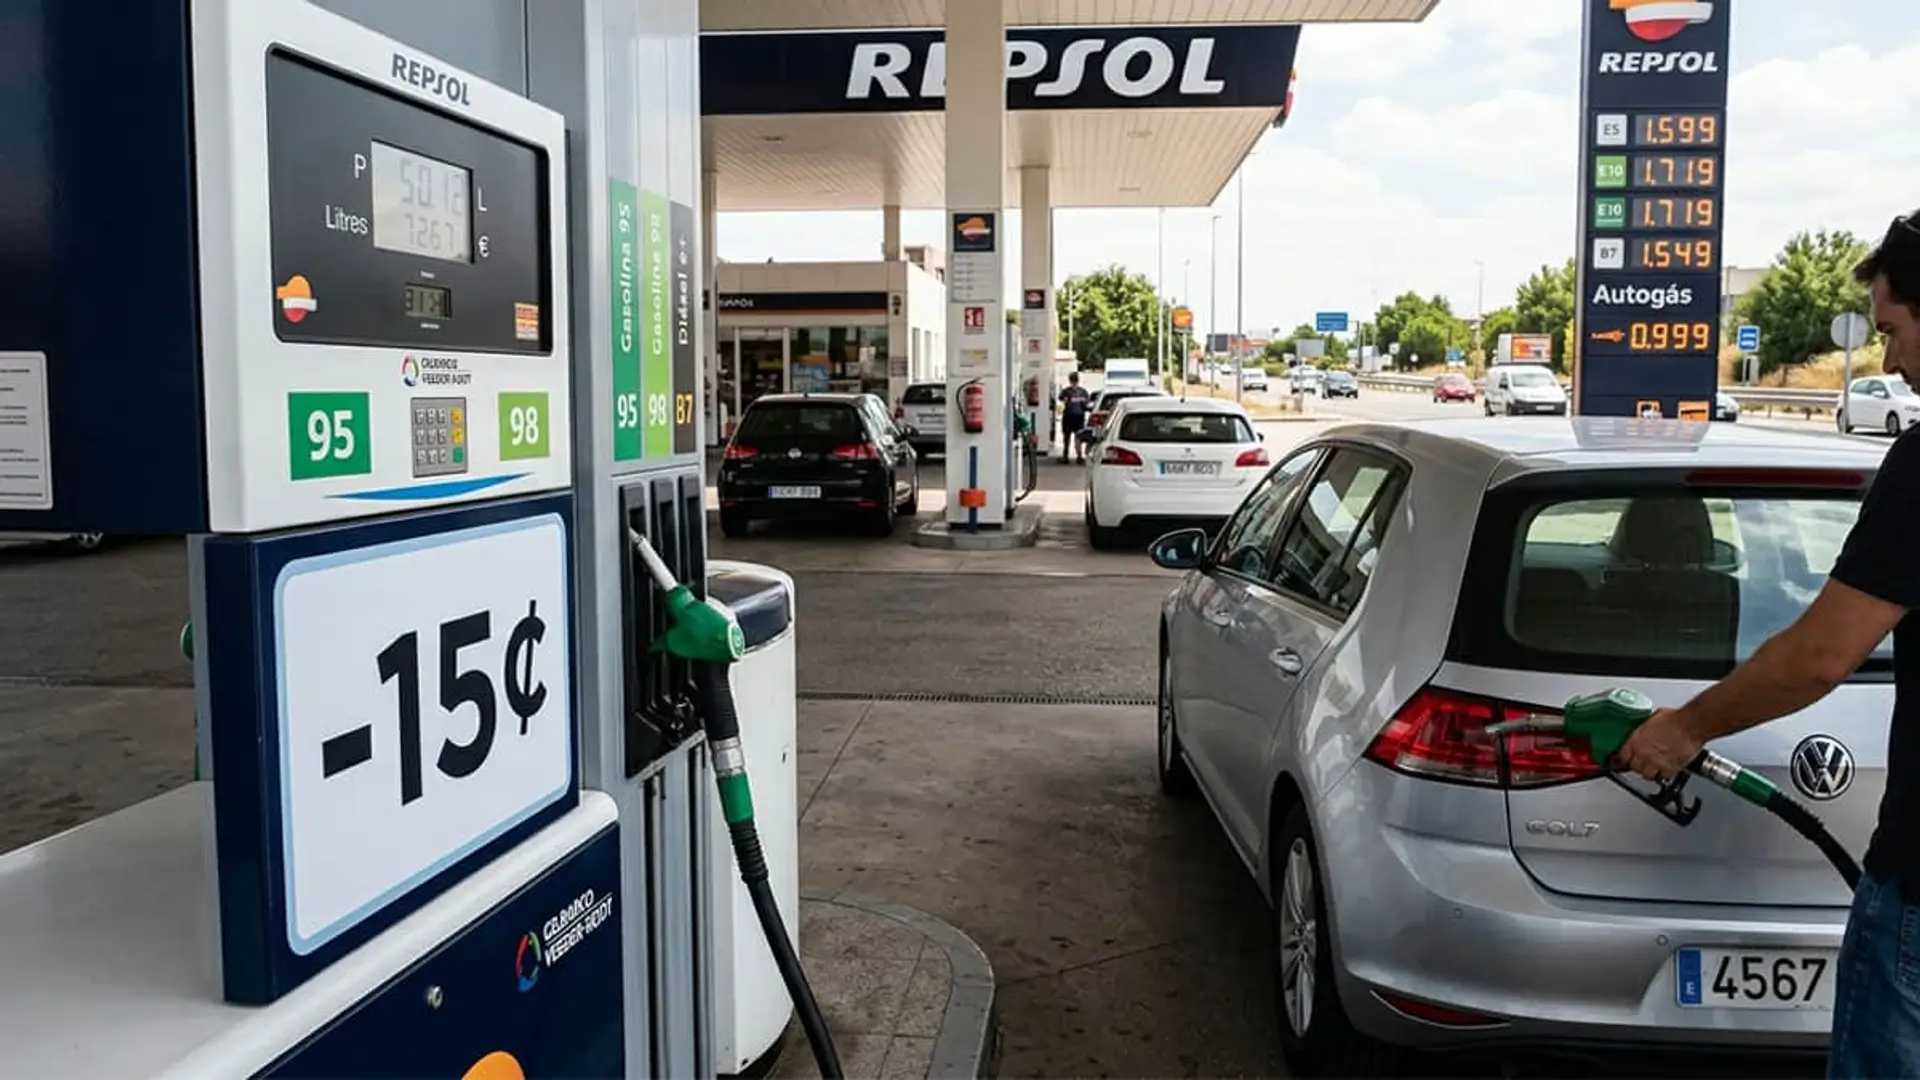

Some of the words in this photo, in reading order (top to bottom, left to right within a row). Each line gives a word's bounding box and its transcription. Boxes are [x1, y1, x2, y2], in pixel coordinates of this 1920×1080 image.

[1598, 51, 1718, 73] REPSOL
[391, 53, 471, 106] REPSOL
[1646, 116, 1716, 144] 1.599
[1599, 164, 1624, 178] E10
[1645, 157, 1714, 185] 1.719
[325, 204, 368, 235] Litres
[1597, 203, 1622, 217] E10
[1644, 199, 1713, 226] 1.719
[1642, 241, 1711, 268] 1.549
[1593, 283, 1693, 309] Autogás
[1630, 322, 1710, 349] 0.999
[617, 394, 637, 428] 95
[648, 393, 667, 426] 98
[307, 409, 355, 461] 95
[509, 406, 539, 446] 98
[321, 599, 547, 806] -15¢
[1686, 982, 1696, 995] E
[1712, 956, 1828, 1002] 4567
